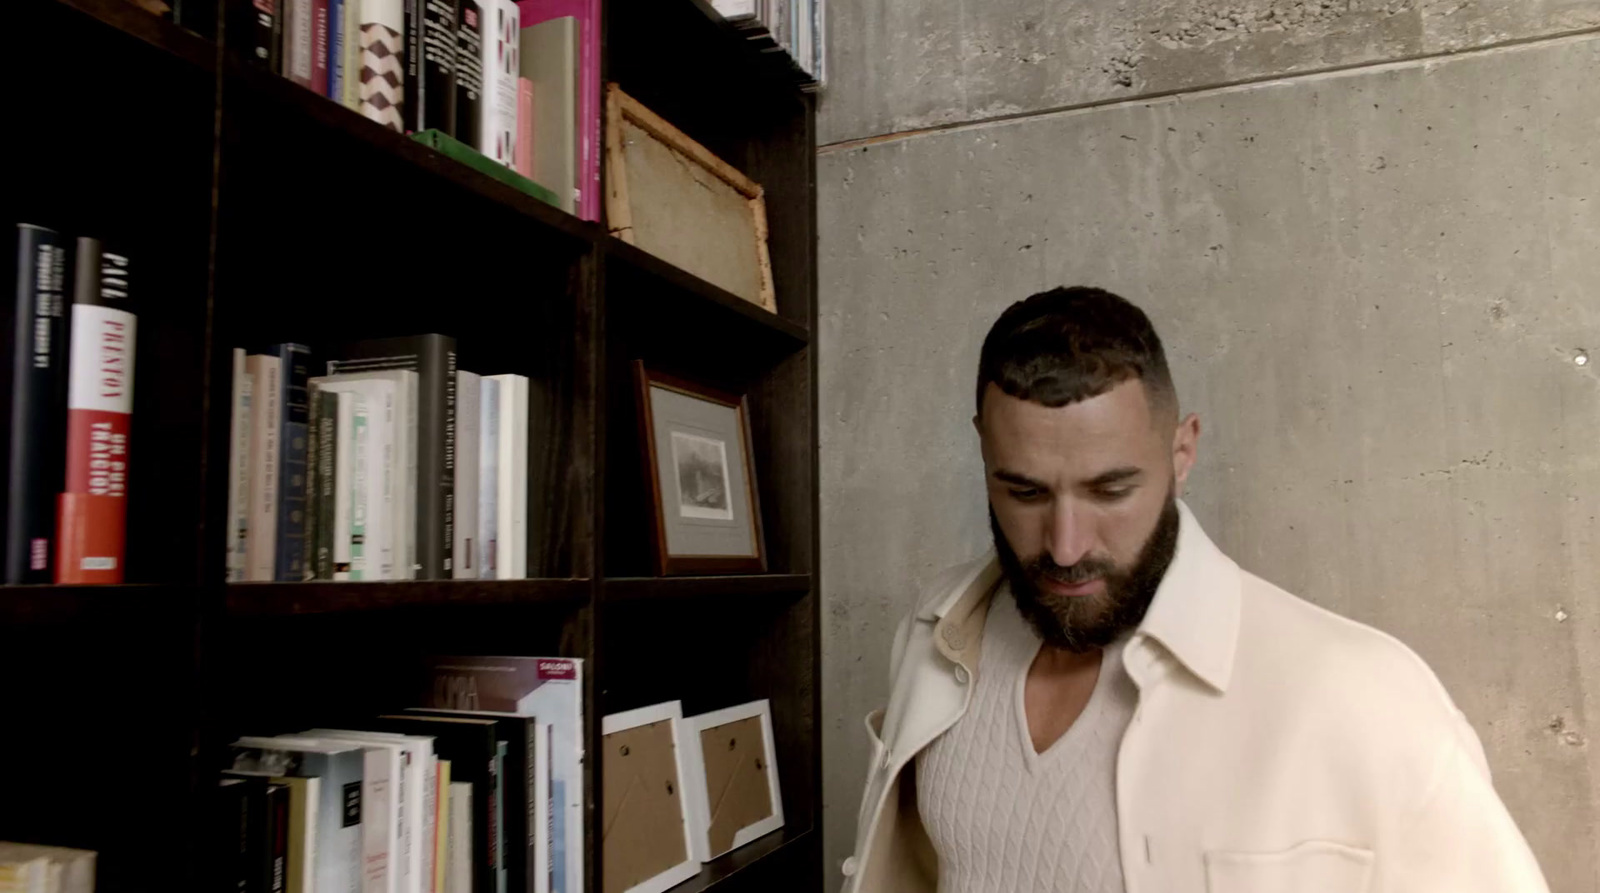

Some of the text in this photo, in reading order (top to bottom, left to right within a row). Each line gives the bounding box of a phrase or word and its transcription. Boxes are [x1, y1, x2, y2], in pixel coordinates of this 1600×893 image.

[101, 252, 129, 398] PAUL PRESTON
[109, 433, 127, 455] UN
